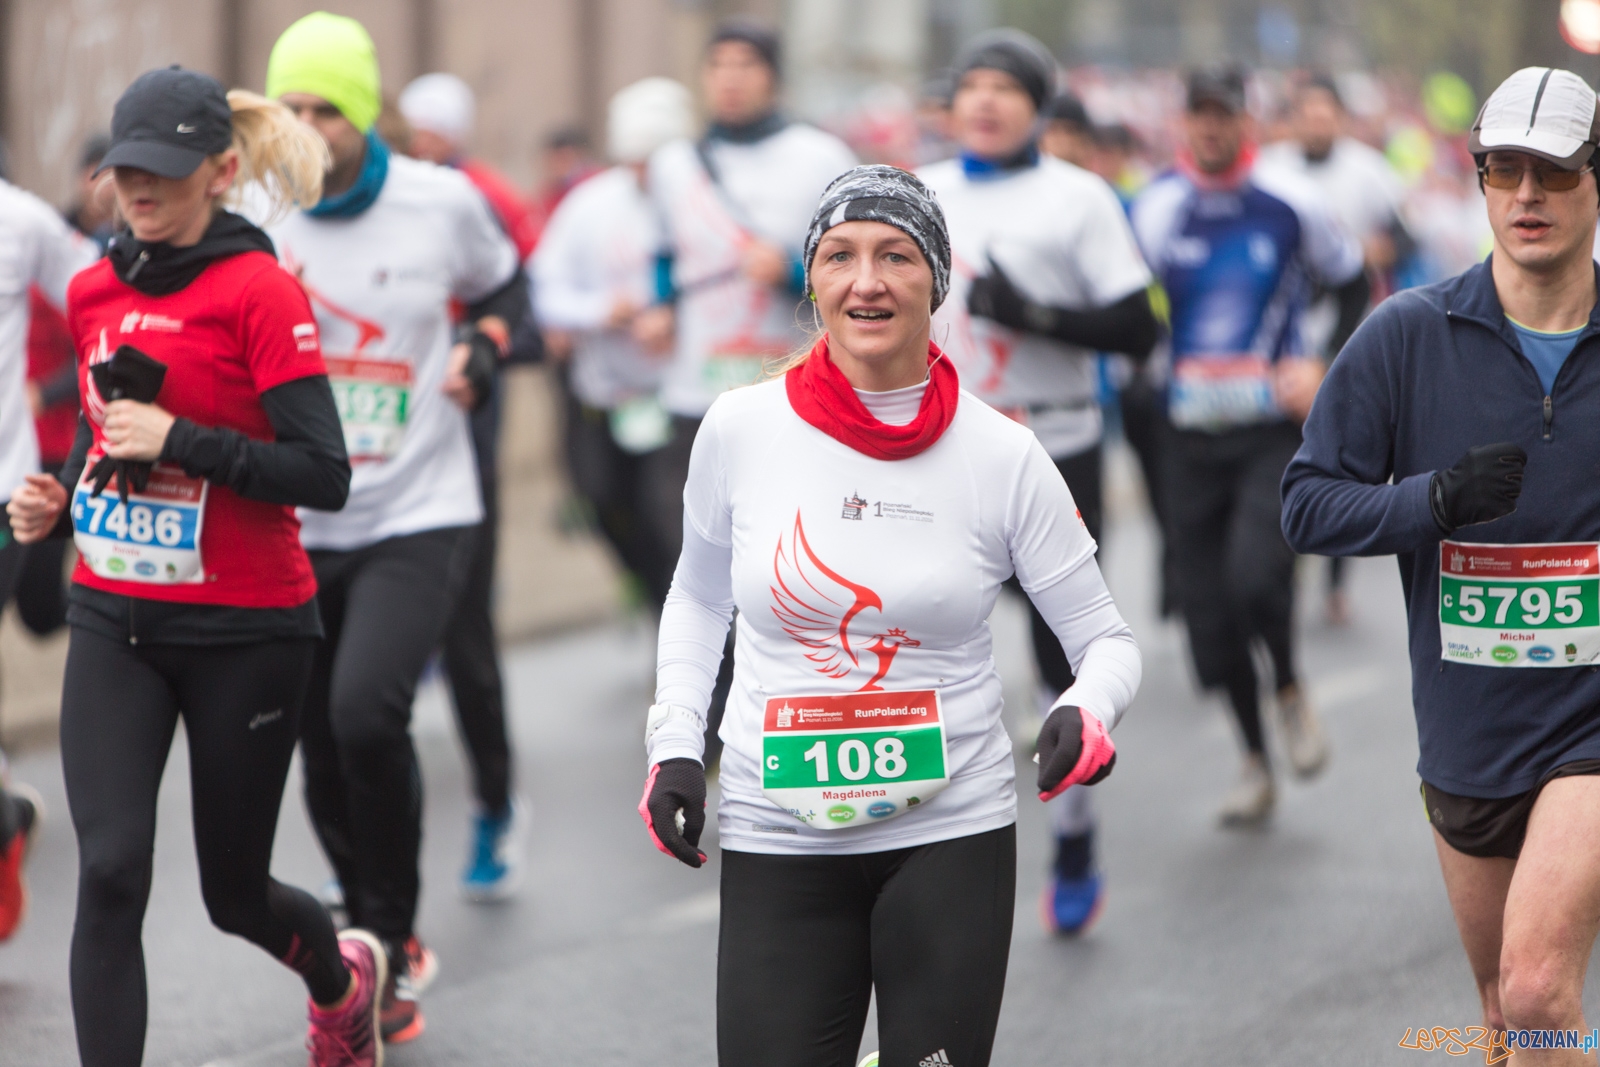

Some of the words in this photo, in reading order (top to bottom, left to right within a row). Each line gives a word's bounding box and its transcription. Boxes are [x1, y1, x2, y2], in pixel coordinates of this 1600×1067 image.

[873, 501, 883, 517] 1
[86, 497, 183, 547] 7486
[1468, 555, 1476, 570] 1
[1522, 557, 1590, 569] RunPoland.org
[1443, 593, 1454, 608] C
[1458, 585, 1584, 625] 5795
[1499, 632, 1536, 642] Michał
[1448, 642, 1470, 652] GRUPA
[797, 707, 805, 723] 1
[854, 705, 927, 718] RunPoland.org
[766, 755, 780, 770] C
[803, 736, 908, 783] 108
[822, 788, 887, 801] Magdalena
